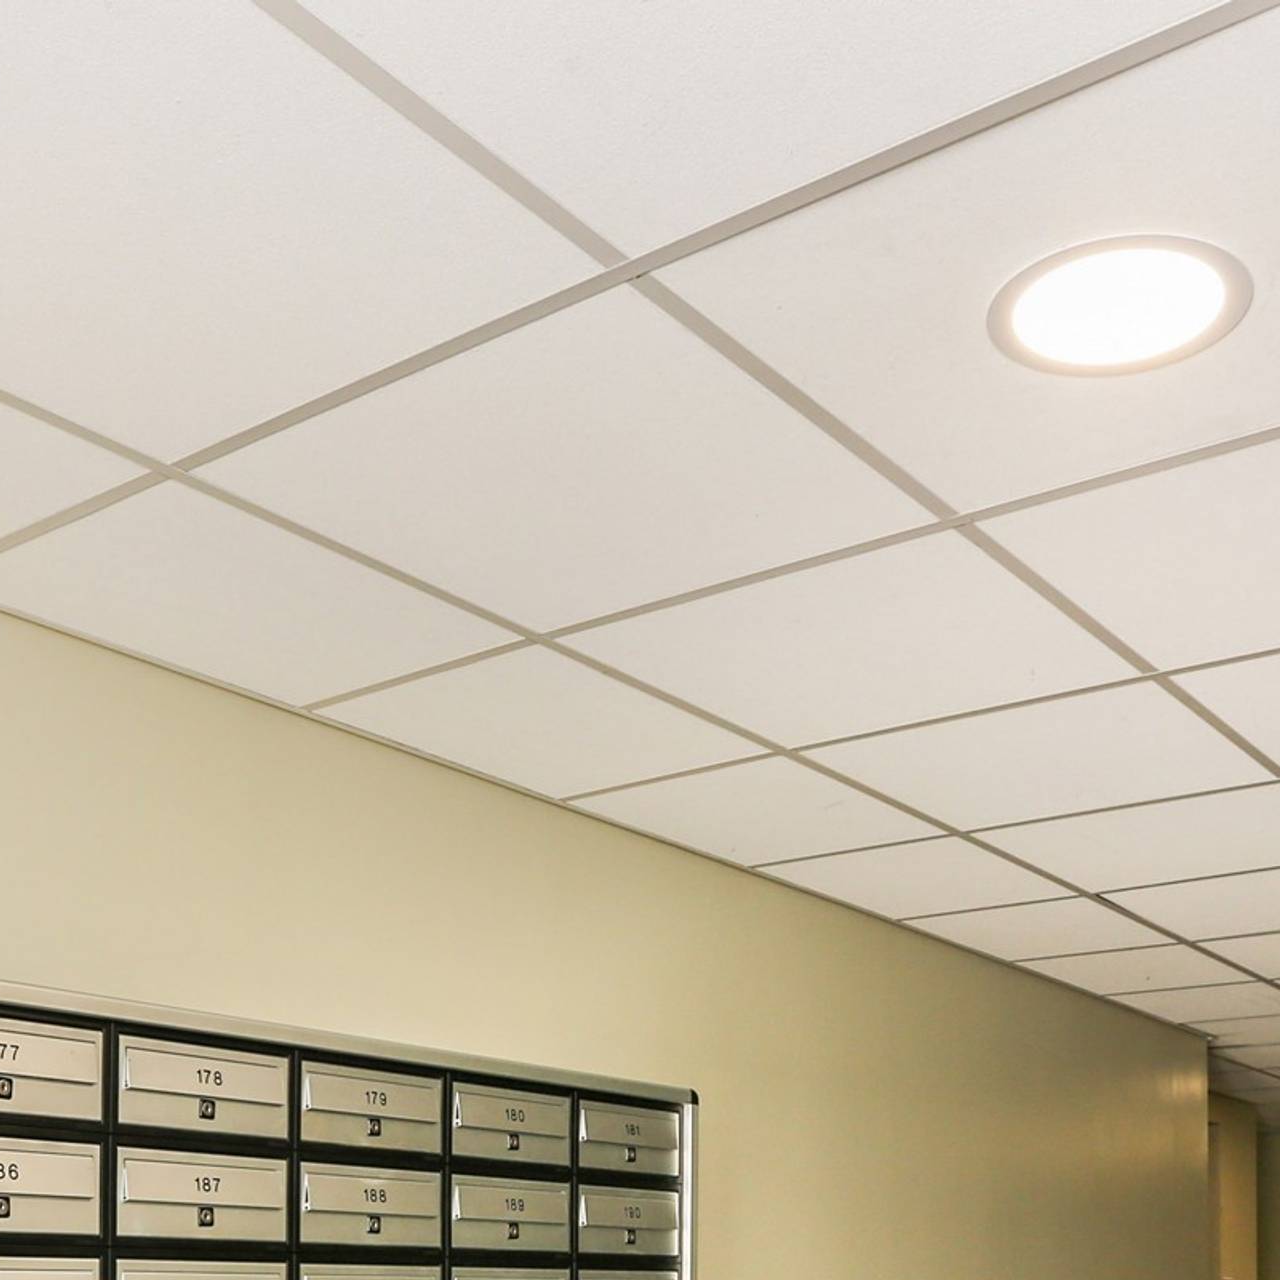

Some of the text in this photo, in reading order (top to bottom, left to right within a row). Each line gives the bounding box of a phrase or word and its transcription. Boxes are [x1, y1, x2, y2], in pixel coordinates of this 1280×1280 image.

[196, 1068, 223, 1087] 178
[365, 1090, 388, 1107] 179
[505, 1108, 526, 1124] 180
[194, 1177, 221, 1193] 187
[363, 1188, 387, 1204] 188
[505, 1197, 525, 1213] 189
